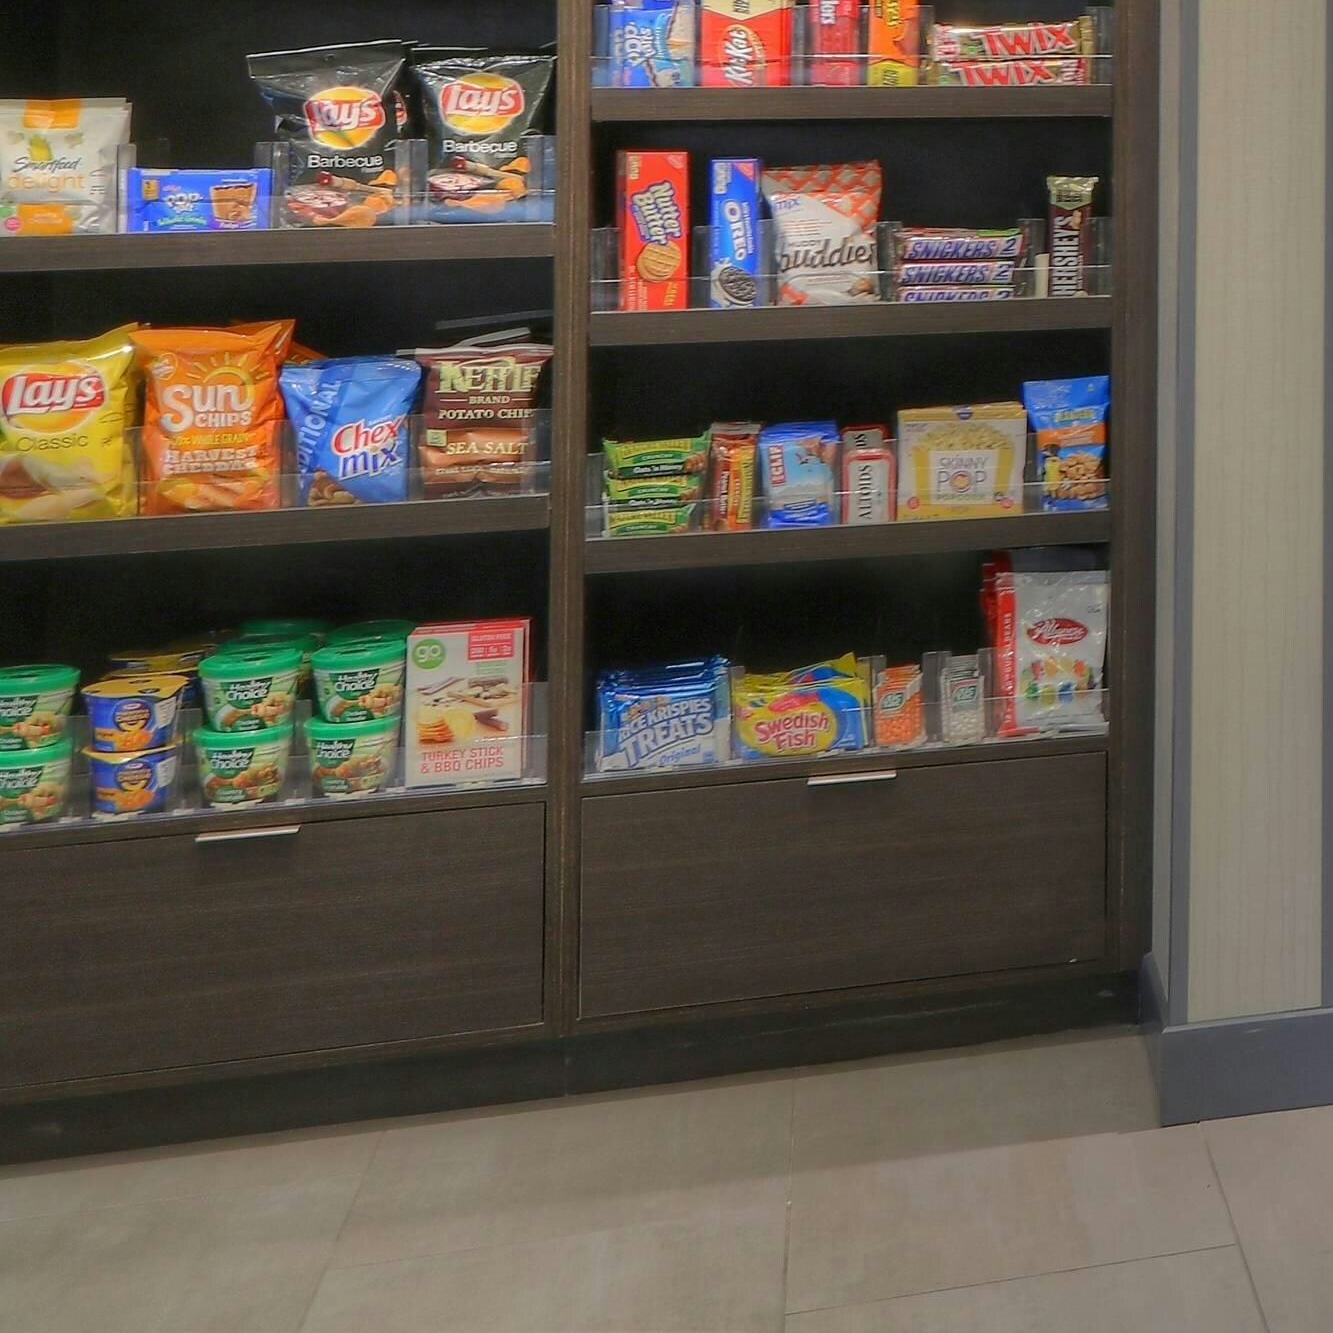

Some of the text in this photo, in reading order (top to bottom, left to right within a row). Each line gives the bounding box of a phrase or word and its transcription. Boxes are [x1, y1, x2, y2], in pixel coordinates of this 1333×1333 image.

[977, 25, 1077, 56] TWIX
[443, 139, 518, 154] Barbecue
[308, 154, 383, 169] Barbecue
[724, 200, 747, 261] OREO
[908, 241, 997, 258] SNICKERS
[902, 266, 989, 284] SNICKERS
[160, 382, 254, 433] Sun
[469, 396, 510, 404] BRAND
[194, 411, 252, 428] CHIPS
[439, 409, 494, 419] POTATO
[16, 433, 89, 452] Classic
[333, 414, 407, 454] Chex
[447, 442, 528, 454] SEA SALT
[859, 464, 873, 520] ALTOIDS
[647, 697, 712, 725] KRISPIES
[754, 714, 828, 743] Swedish
[620, 712, 714, 767] TREATS
[774, 730, 817, 750] Fish
[422, 745, 504, 762] TURKEY STICK
[420, 756, 504, 774] & BBQ CHIPS
